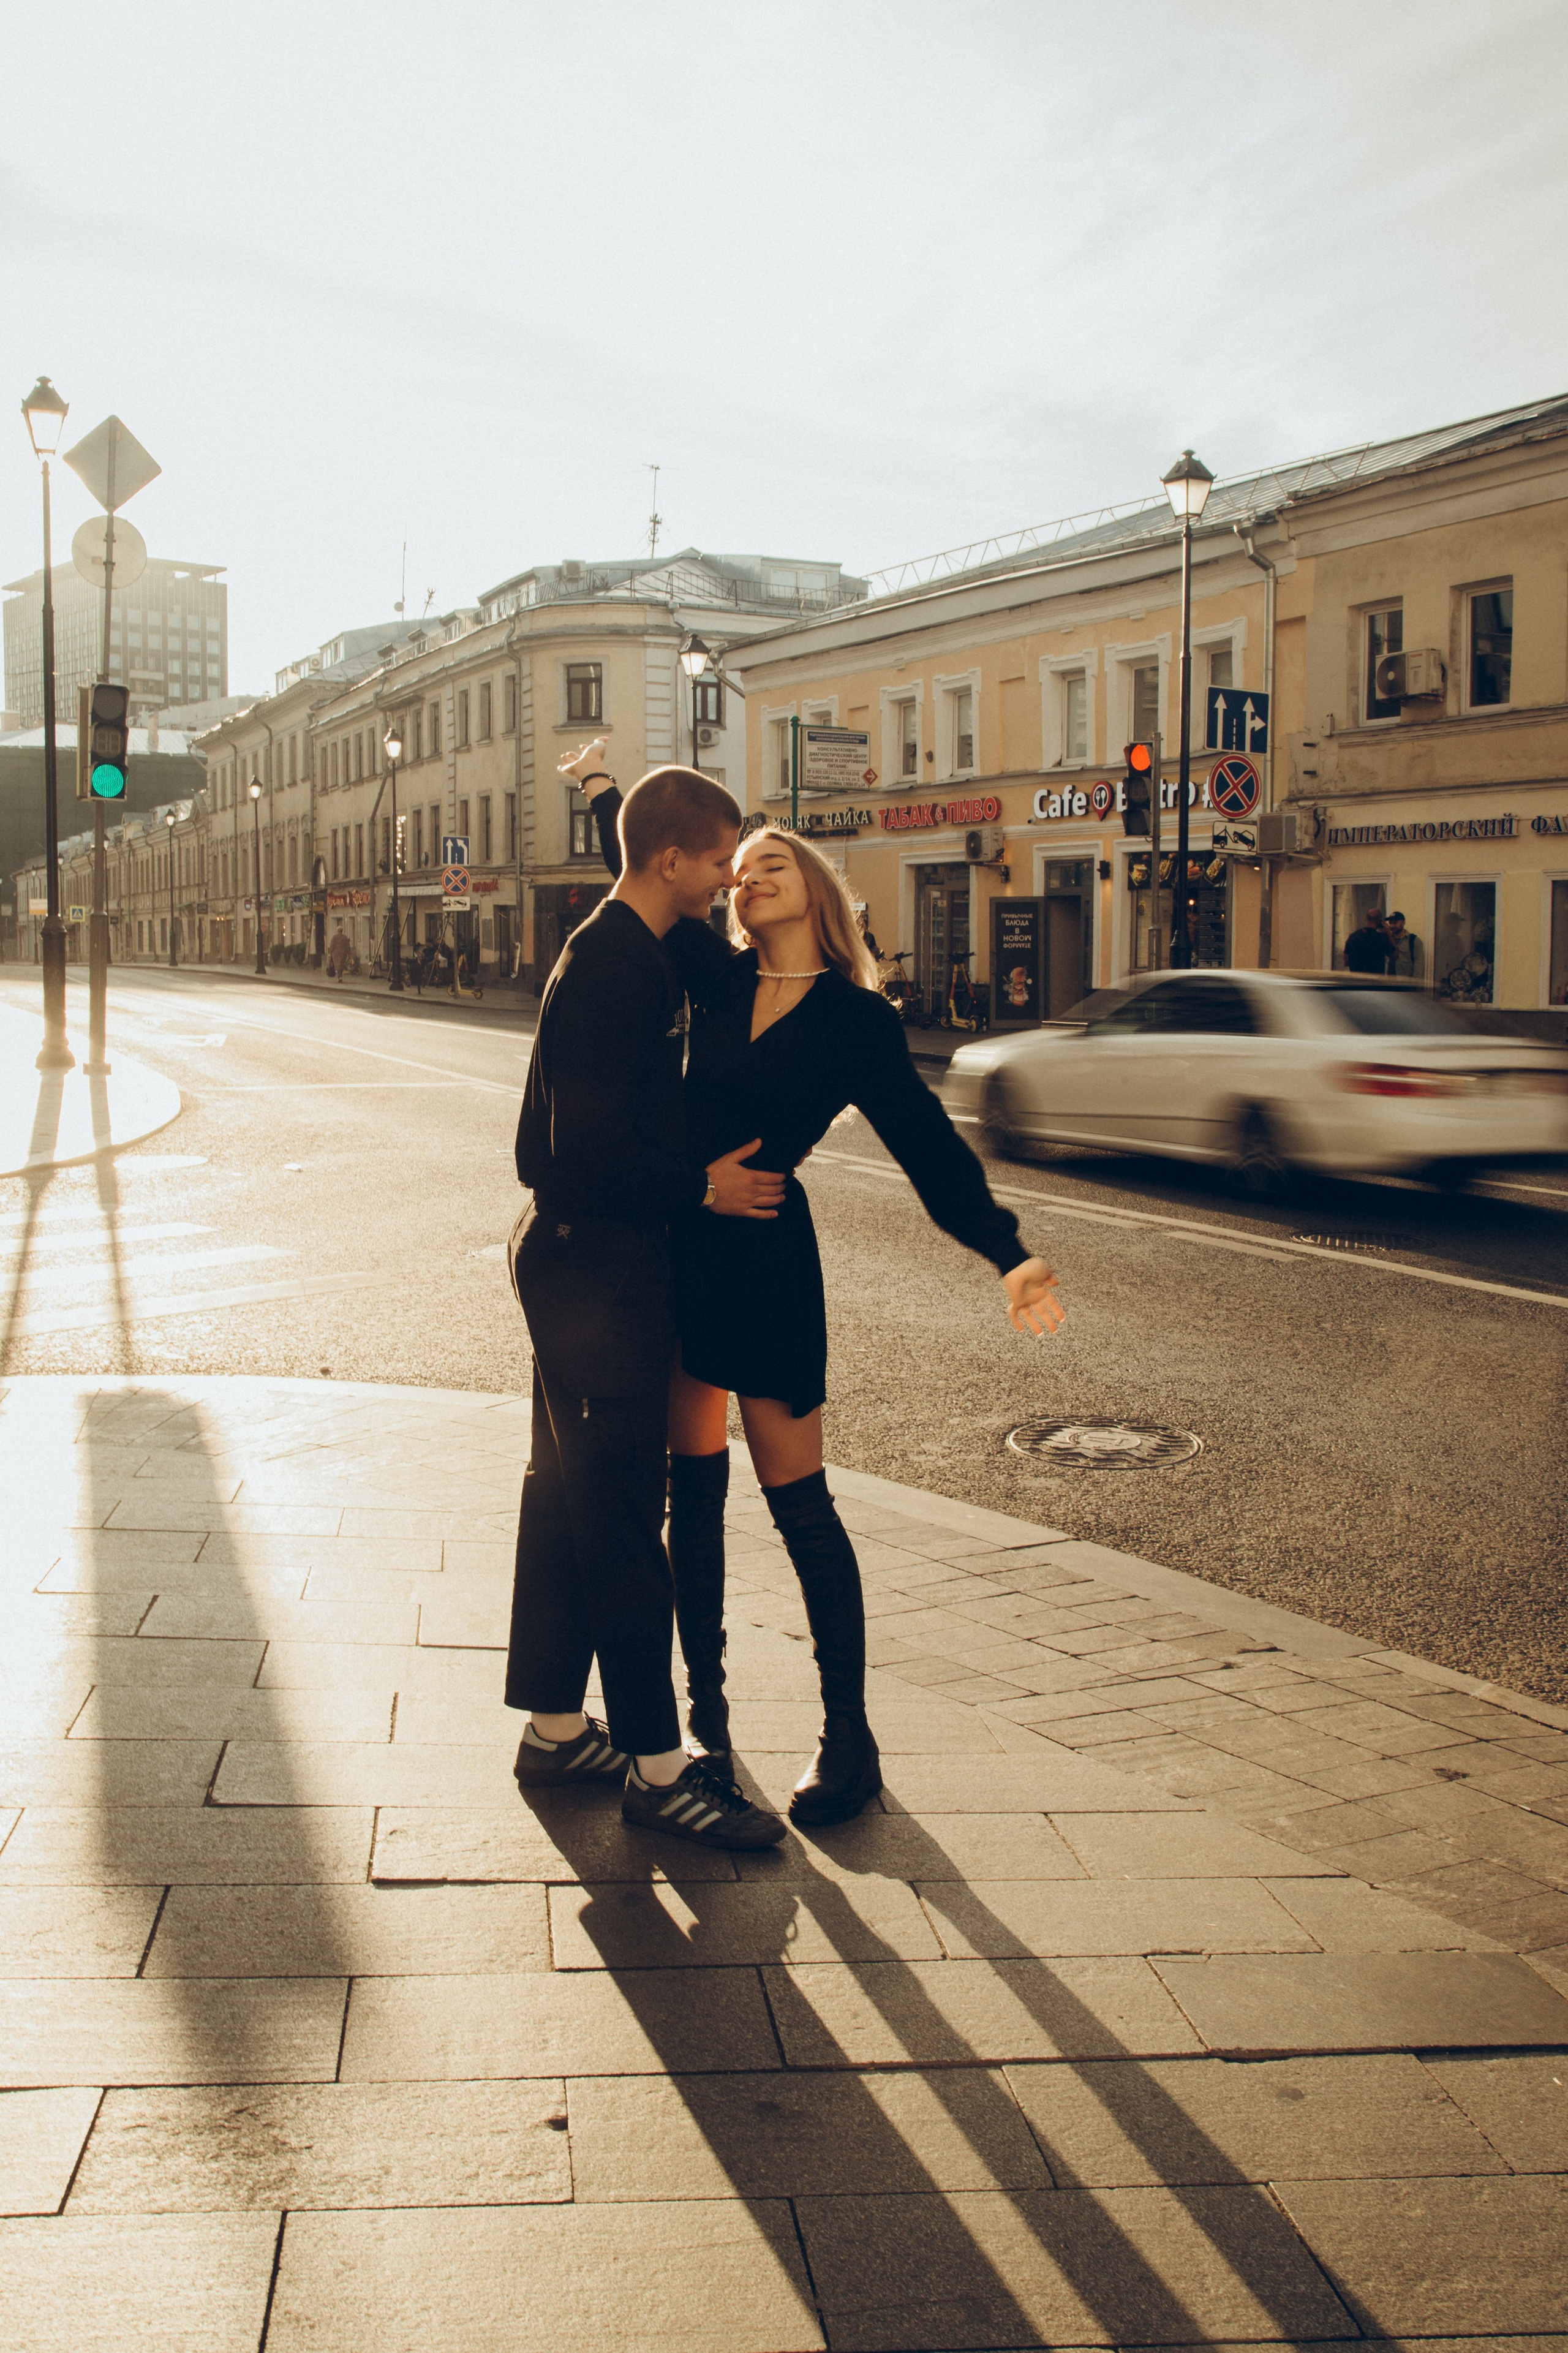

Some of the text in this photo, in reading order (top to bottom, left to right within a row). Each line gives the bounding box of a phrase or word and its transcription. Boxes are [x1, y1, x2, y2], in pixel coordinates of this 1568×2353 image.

[826, 806, 870, 827] ЧАЙКА
[878, 796, 998, 830] ТАБАК & ПИВО
[1033, 784, 1087, 819] Cafe
[1327, 812, 1568, 845] ИМПЕРАТОРСКИЙ ФА
